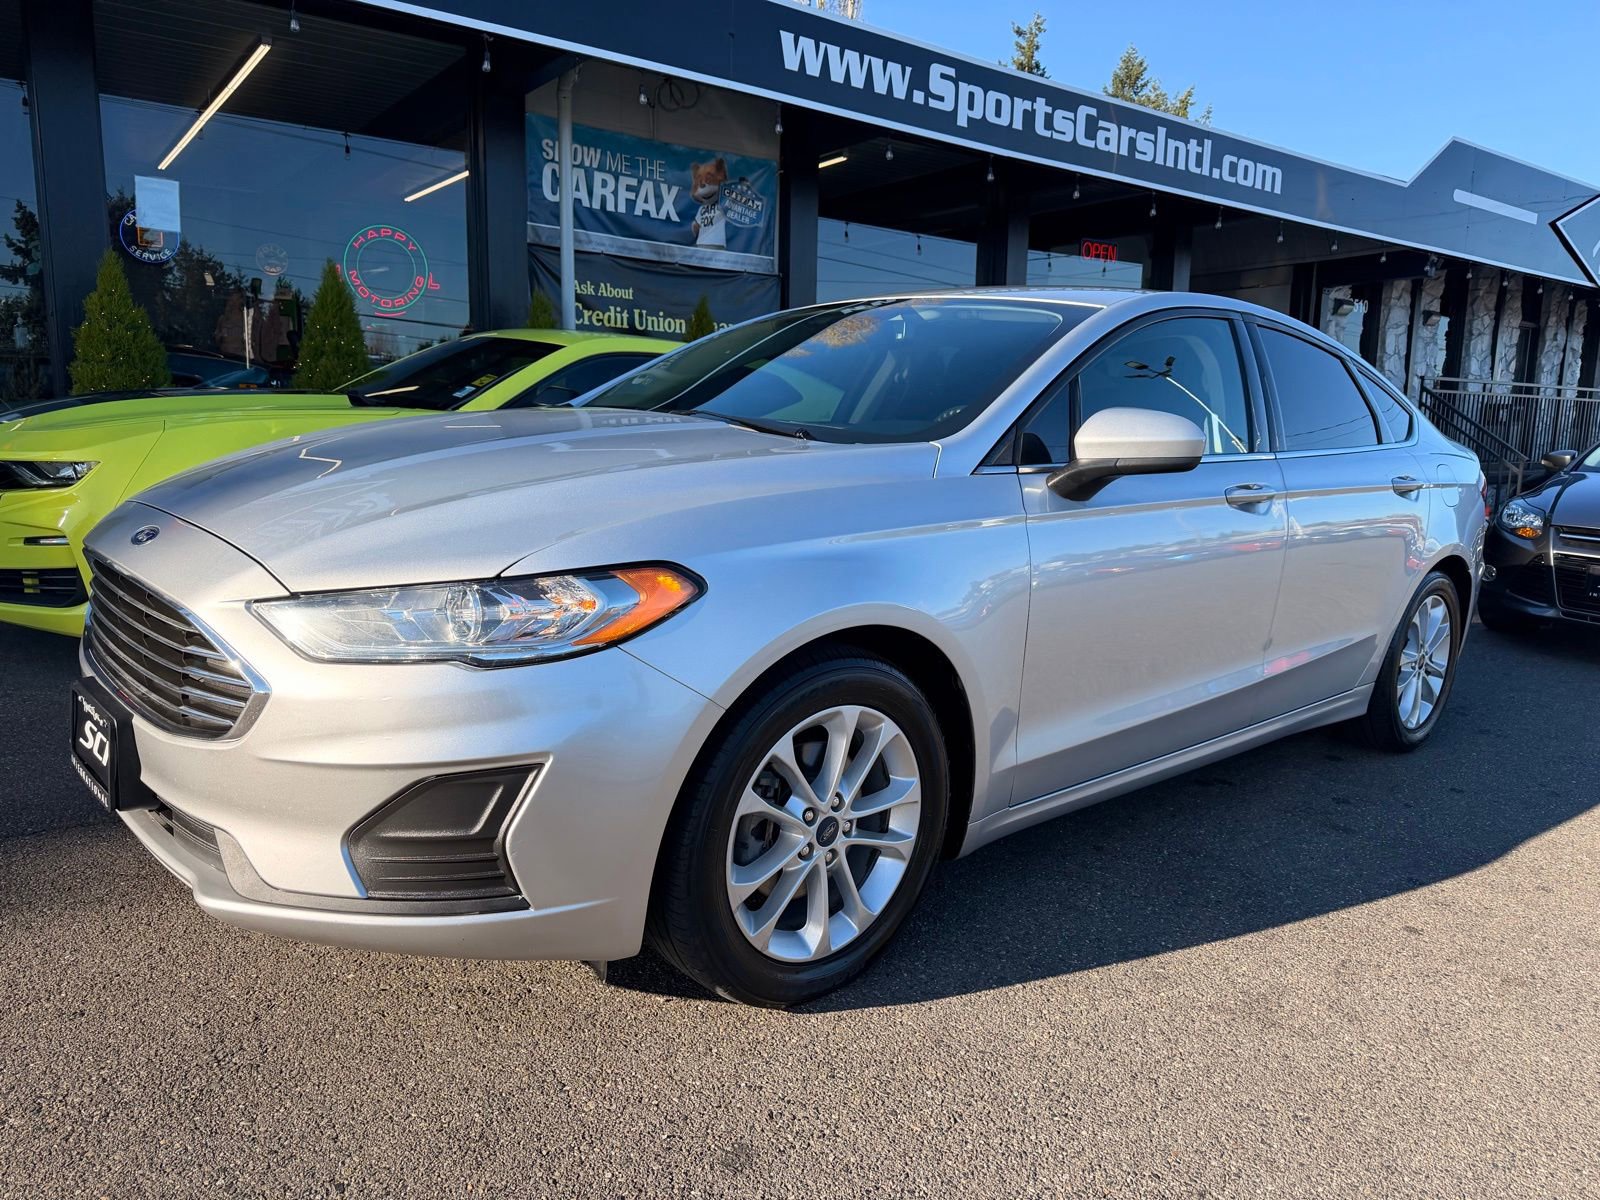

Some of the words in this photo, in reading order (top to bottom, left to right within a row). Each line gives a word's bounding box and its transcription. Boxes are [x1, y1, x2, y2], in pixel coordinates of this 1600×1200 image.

[779, 29, 1283, 195] www.SportsCarsIntl.com
[606, 150, 632, 175] ME
[635, 156, 666, 182] THE
[541, 161, 681, 223] CARFAX
[724, 188, 762, 212] CARFAX
[725, 199, 757, 219] ADVANTAGE
[726, 209, 750, 225] DEALER
[701, 215, 715, 228] FOX
[352, 228, 417, 252] HAPPY
[1082, 241, 1117, 263] OPEN
[129, 245, 173, 261] SERVICE
[348, 270, 424, 308] MOTORING
[574, 279, 596, 296] Ask
[598, 282, 634, 300] About
[575, 302, 629, 330] Credit
[633, 308, 686, 335] Union
[71, 754, 109, 808] INTERNATIONAL
